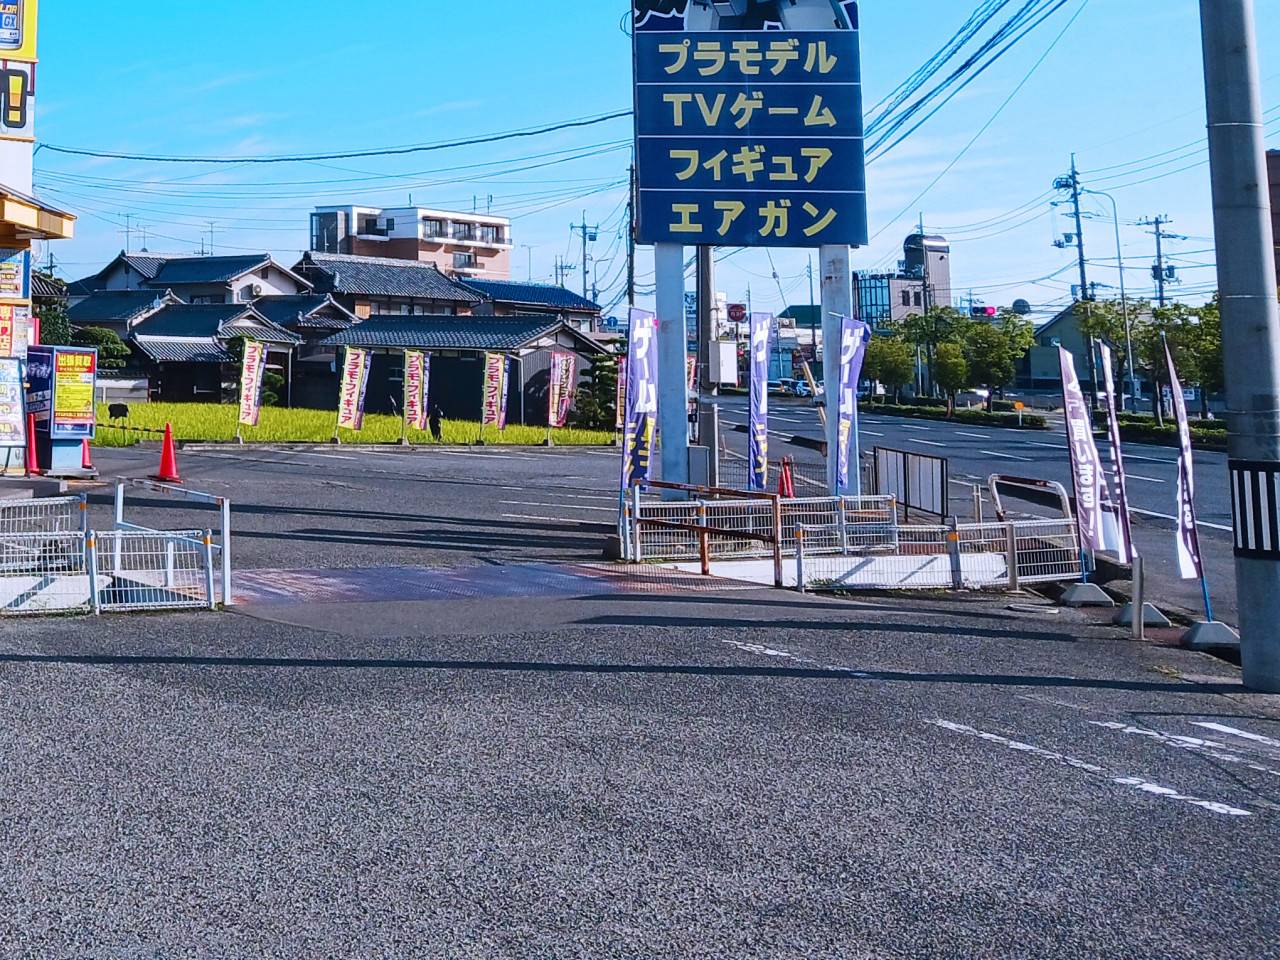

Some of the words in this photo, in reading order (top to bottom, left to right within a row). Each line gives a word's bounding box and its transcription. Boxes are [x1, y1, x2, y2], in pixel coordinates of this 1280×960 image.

[3, 16, 16, 29] GX
[658, 39, 837, 77] プラモデル
[663, 92, 837, 129] TVゲーム
[669, 147, 833, 184] フィギュア
[669, 199, 837, 238] エアガン
